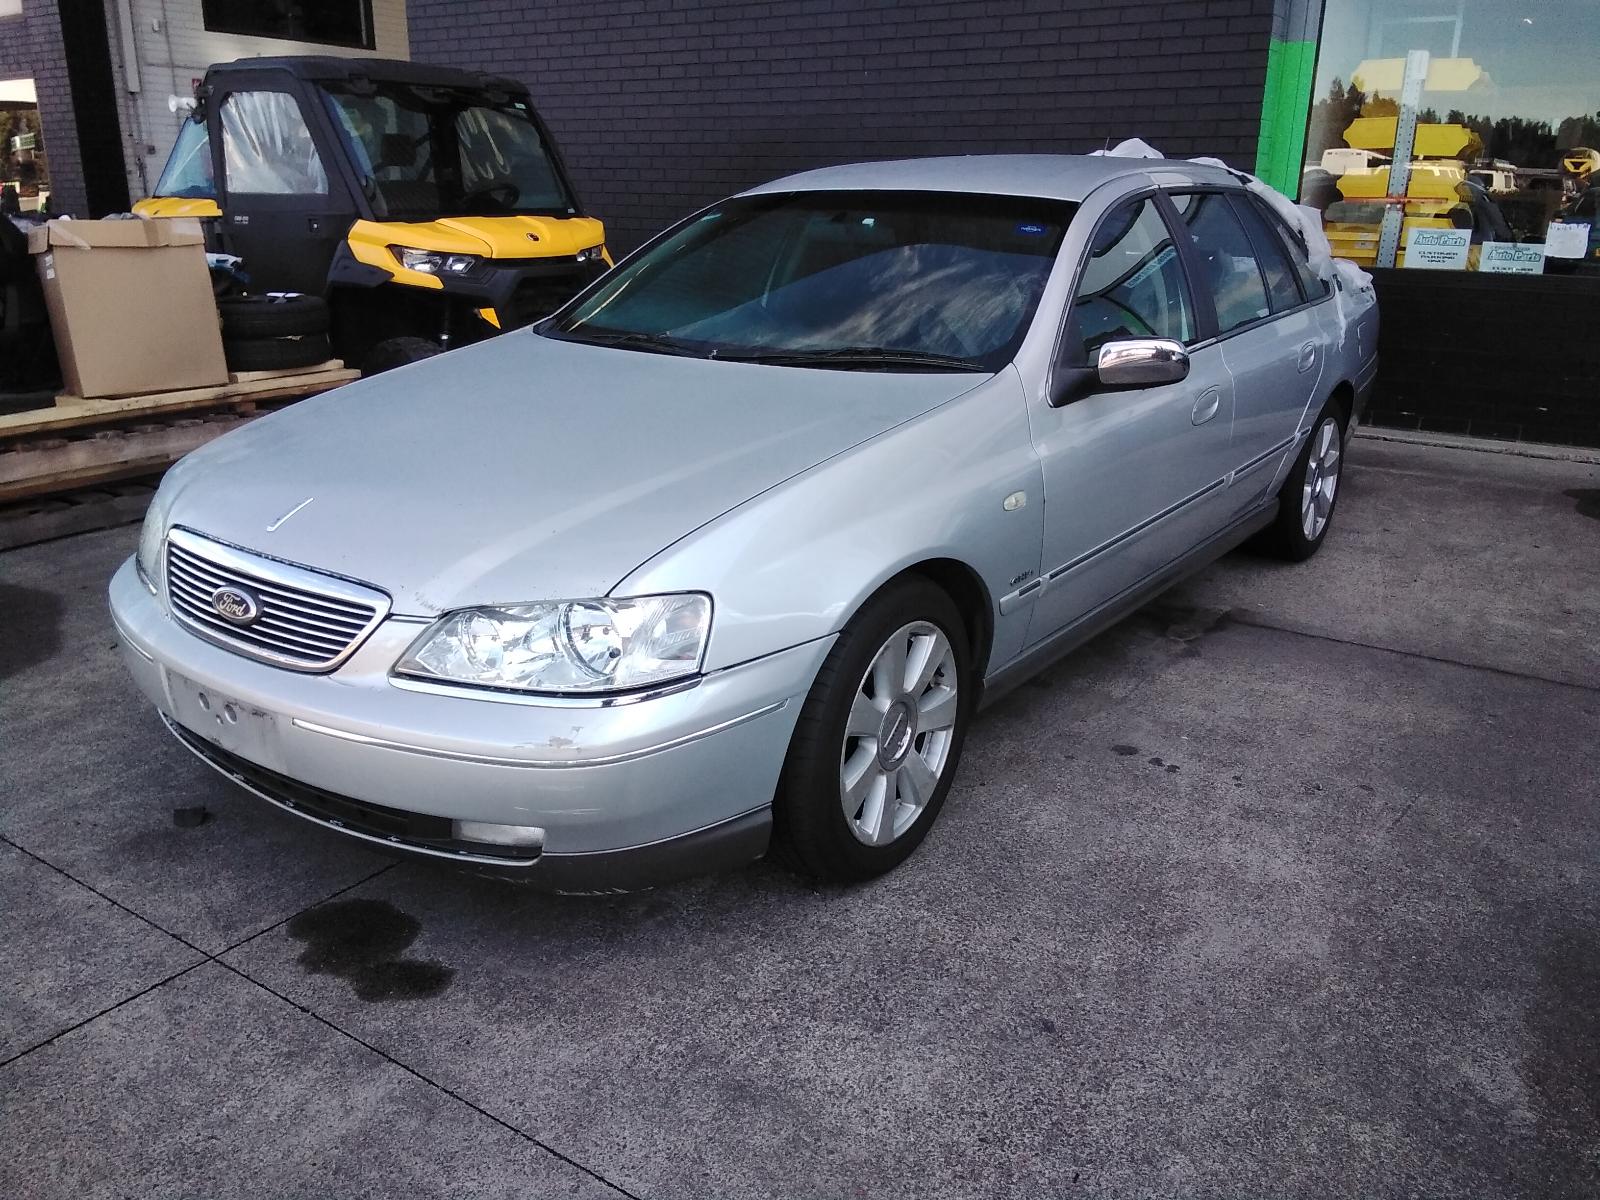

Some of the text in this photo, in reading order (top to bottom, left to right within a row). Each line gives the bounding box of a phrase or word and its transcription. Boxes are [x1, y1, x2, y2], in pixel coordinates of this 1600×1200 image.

[1414, 233, 1466, 246] Auto Parts
[1488, 250, 1541, 262] Auto Parts
[220, 592, 247, 617] Ford
